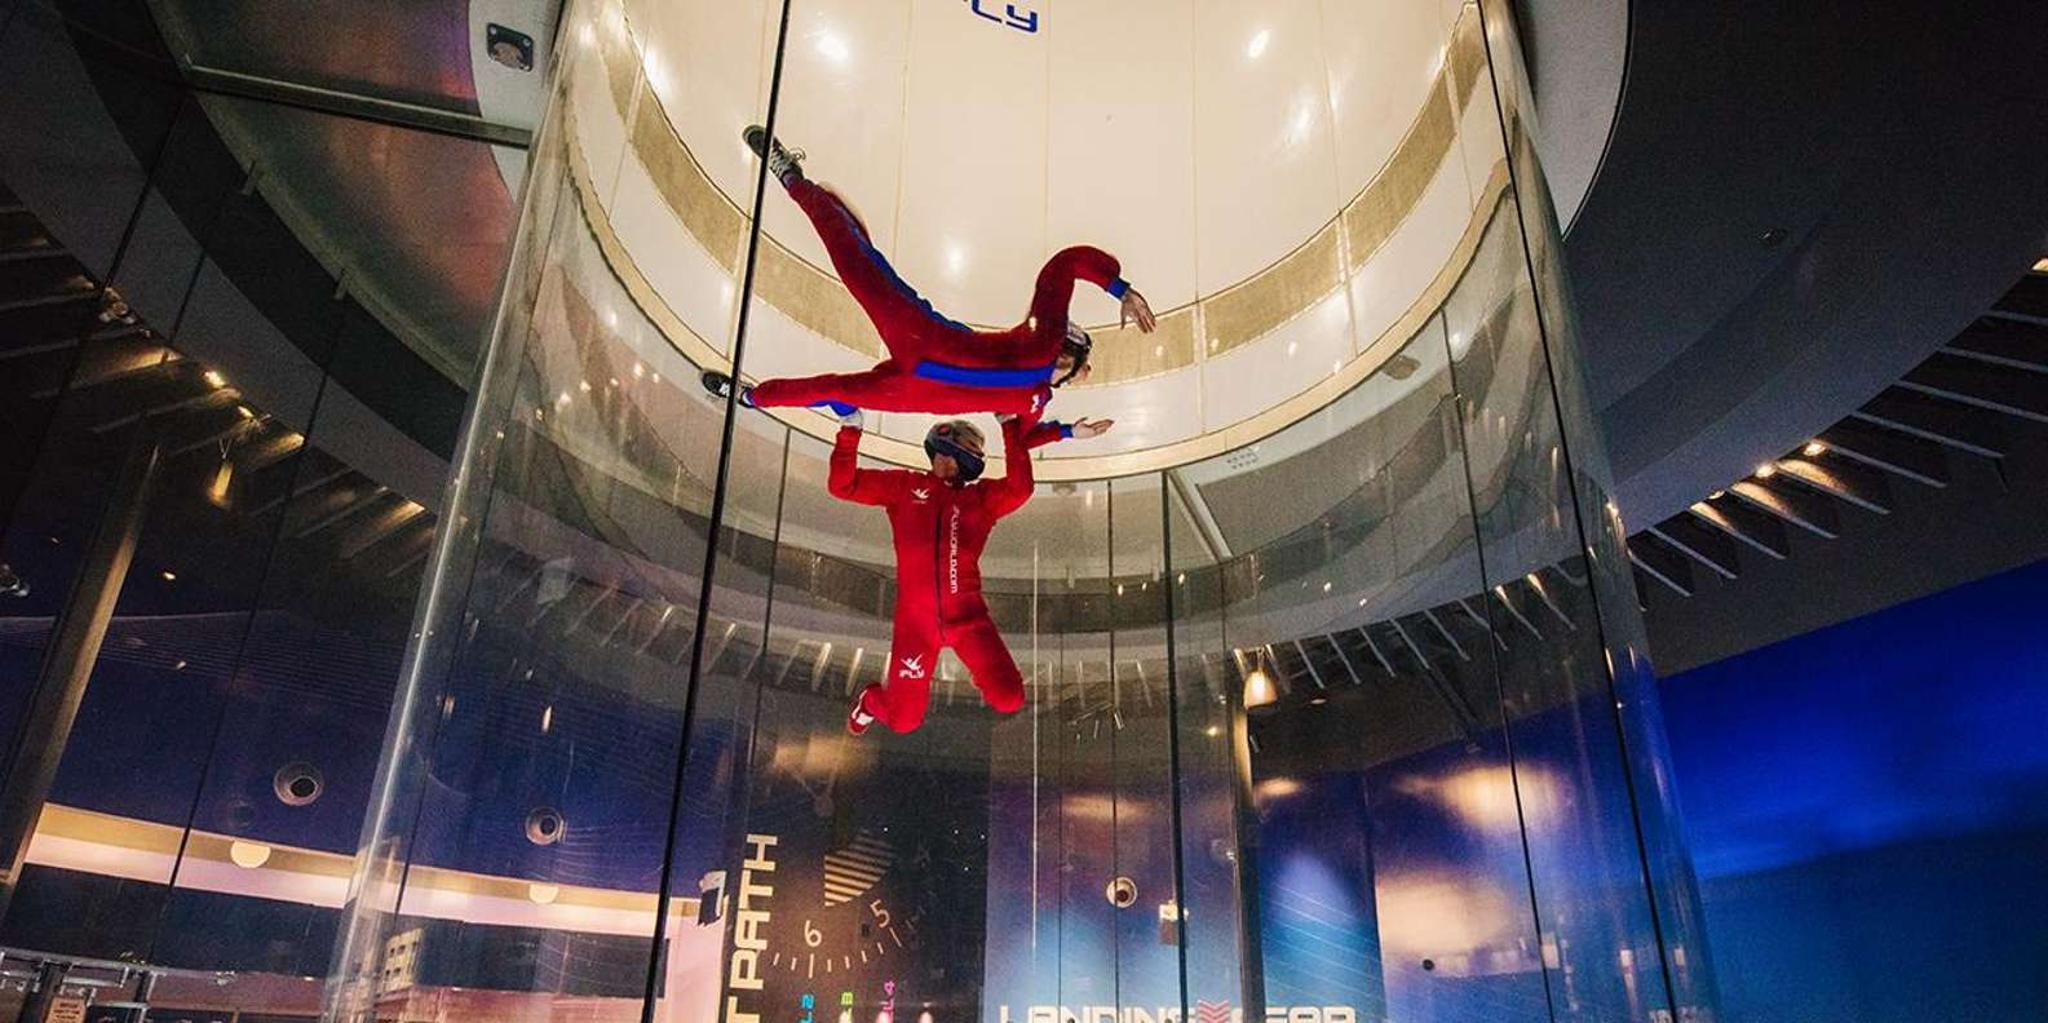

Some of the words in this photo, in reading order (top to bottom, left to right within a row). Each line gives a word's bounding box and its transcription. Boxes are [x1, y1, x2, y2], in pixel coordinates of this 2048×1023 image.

[729, 833, 779, 990] PATH
[870, 899, 890, 929] 5
[804, 919, 823, 947] 6
